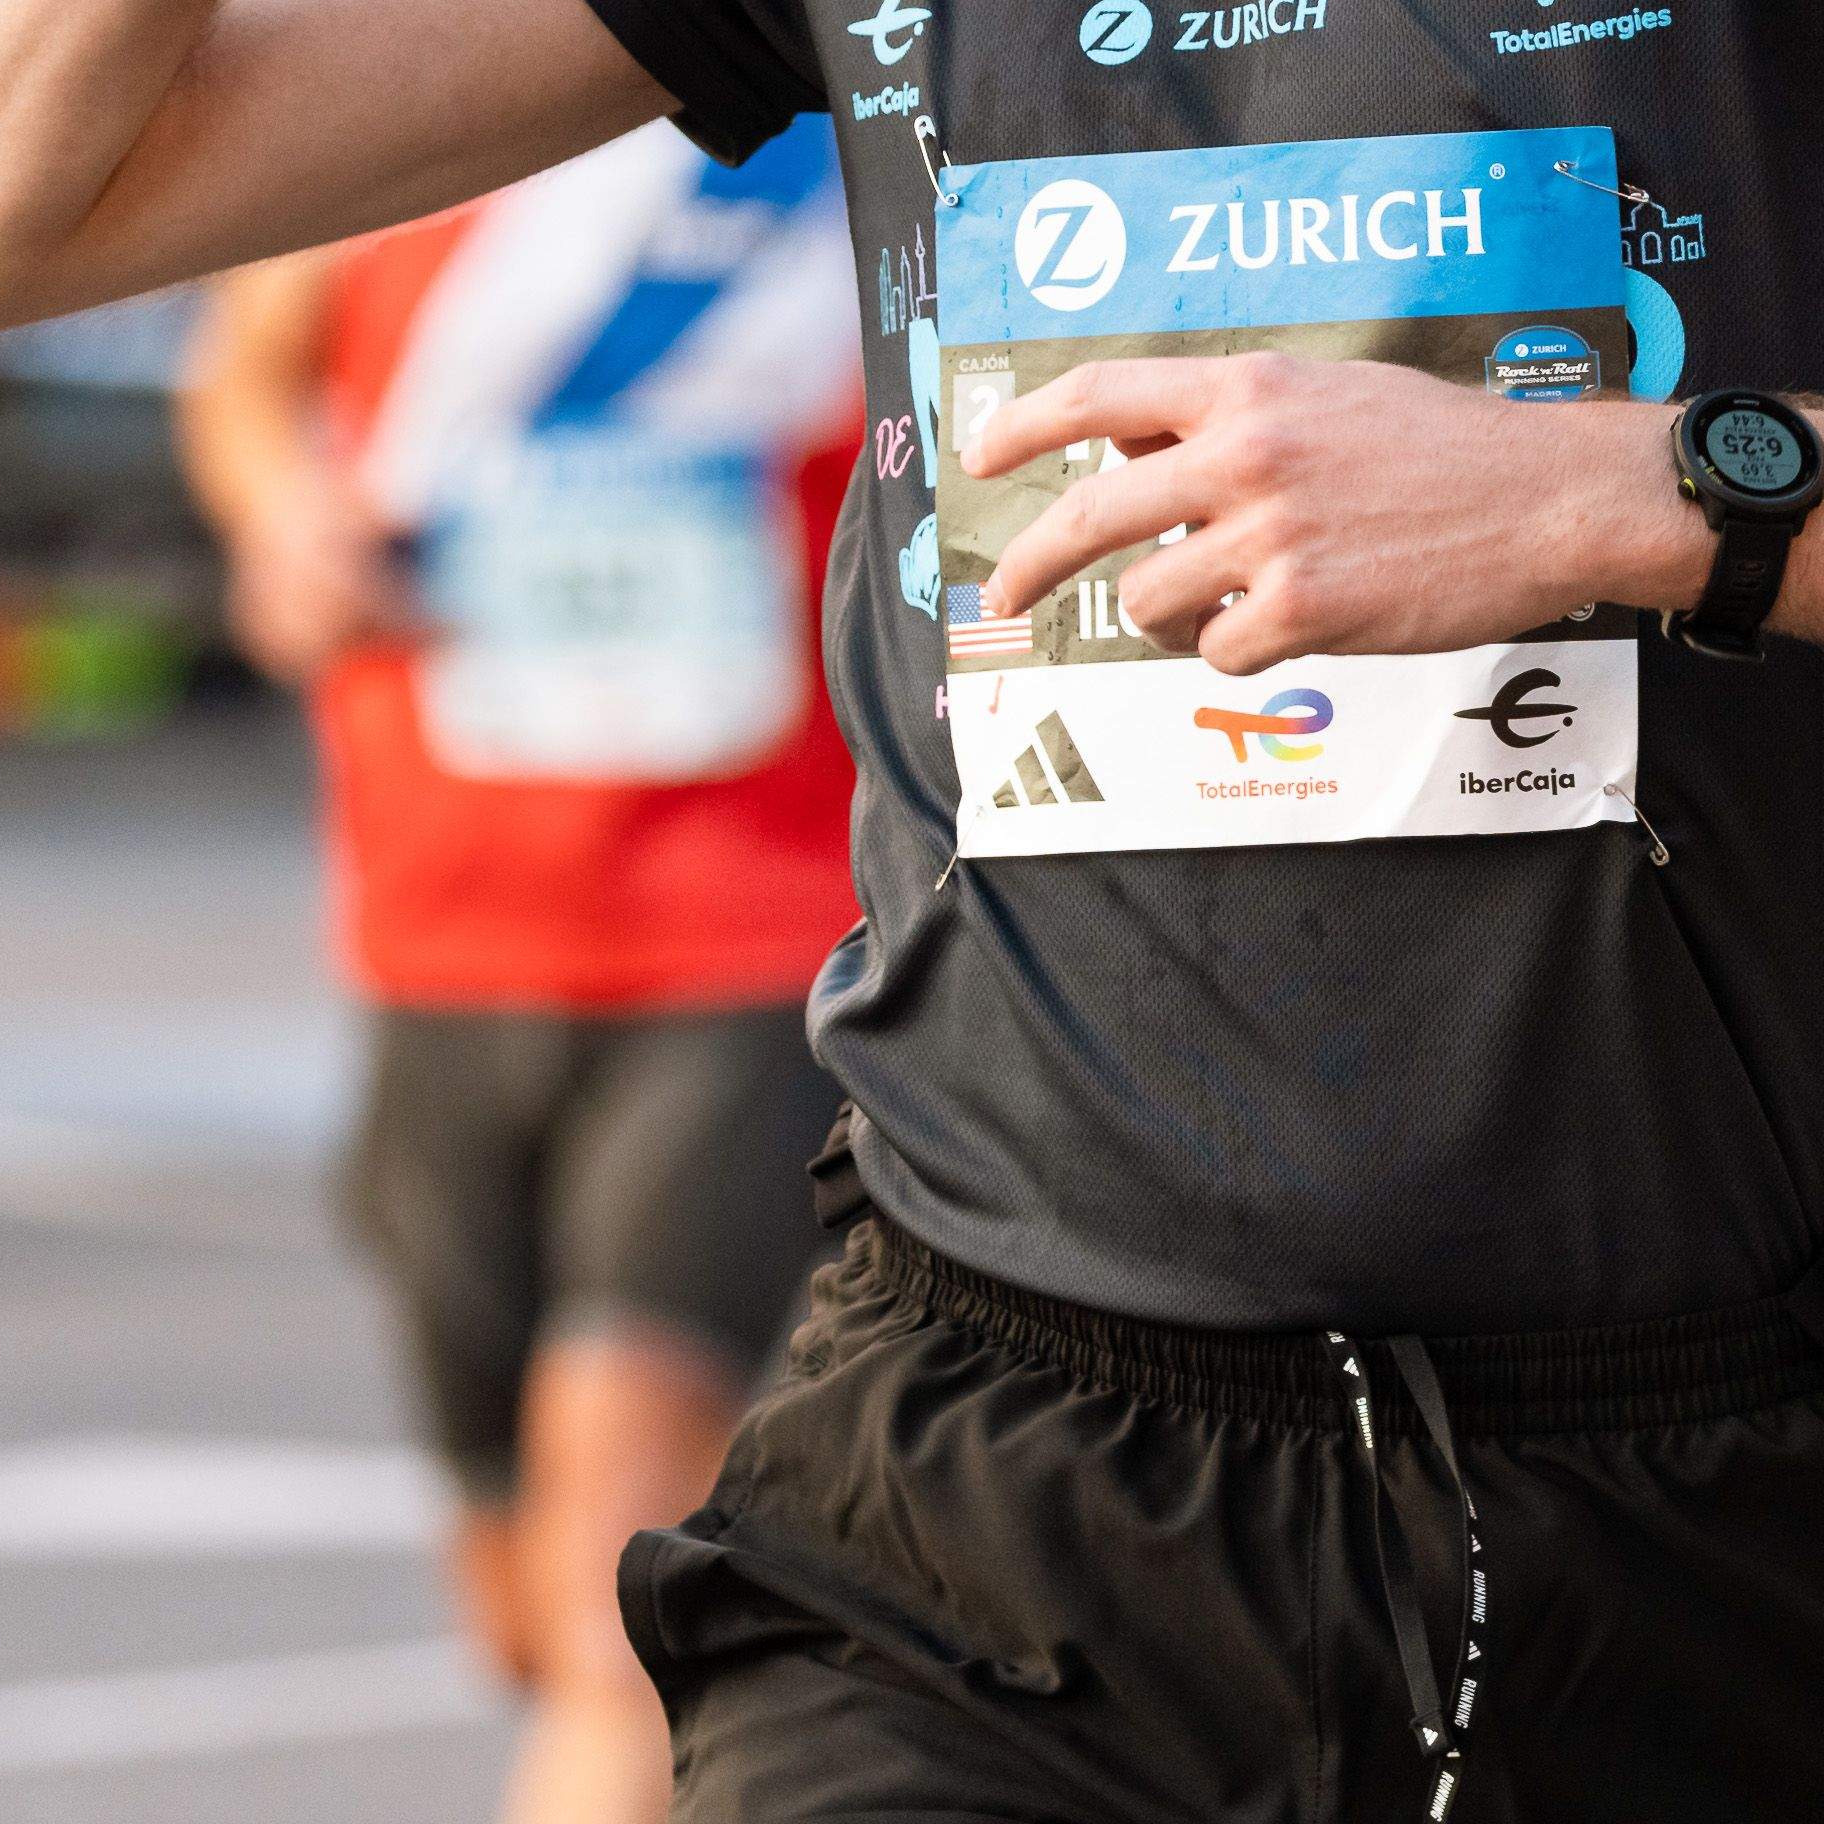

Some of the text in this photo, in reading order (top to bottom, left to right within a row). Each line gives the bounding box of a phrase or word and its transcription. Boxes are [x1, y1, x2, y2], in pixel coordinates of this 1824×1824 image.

[1489, 7, 1672, 55] TotalEnergies
[852, 81, 920, 121] iberCaja
[1165, 186, 1486, 273] ZURICH
[959, 355, 1010, 373] CAJÓN
[1532, 344, 1567, 354] ZURICH
[1548, 375, 1581, 383] SERIES
[876, 415, 915, 480] DE
[1723, 434, 1783, 458] 6:25
[1195, 776, 1339, 800] TotalEnergies
[1459, 767, 1576, 796] iberCaja
[1355, 1396, 1374, 1449] RUNNING
[1472, 1569, 1487, 1624] RUNNING
[1454, 1678, 1478, 1729] RUNNING
[1429, 1770, 1455, 1823] RUNNING
